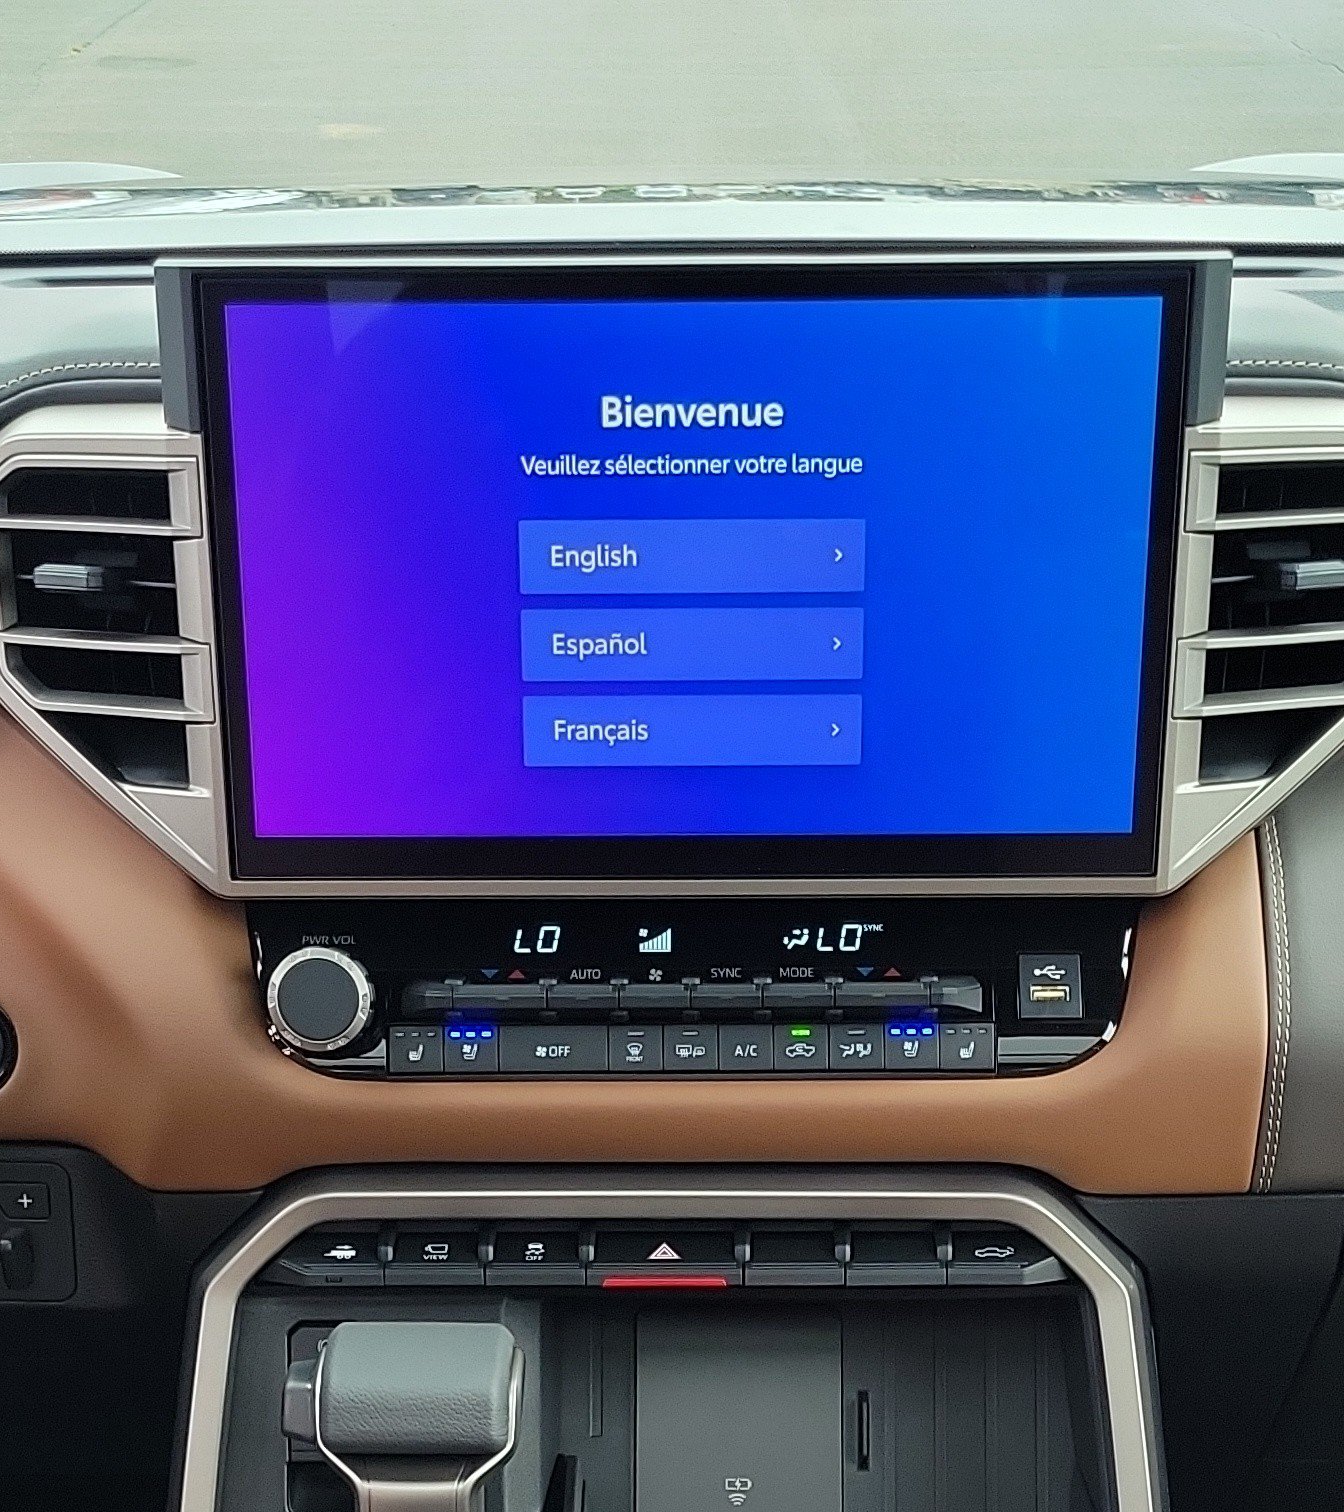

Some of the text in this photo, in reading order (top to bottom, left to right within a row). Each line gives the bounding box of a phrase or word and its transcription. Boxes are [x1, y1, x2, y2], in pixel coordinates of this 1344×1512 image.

[600, 395, 784, 429] Bienvenue
[520, 453, 863, 478] Veuillez sélectionner votre langue
[550, 543, 638, 573] English
[552, 631, 648, 661] Español
[553, 719, 649, 746] Français
[301, 935, 356, 945] PWR VOL
[513, 925, 561, 953] LO
[816, 924, 862, 952] LO
[569, 969, 601, 980] AUTO
[710, 967, 742, 979] SYNC
[779, 967, 814, 978] MODE
[548, 1046, 571, 1057] OFF
[734, 1045, 758, 1057] A/C
